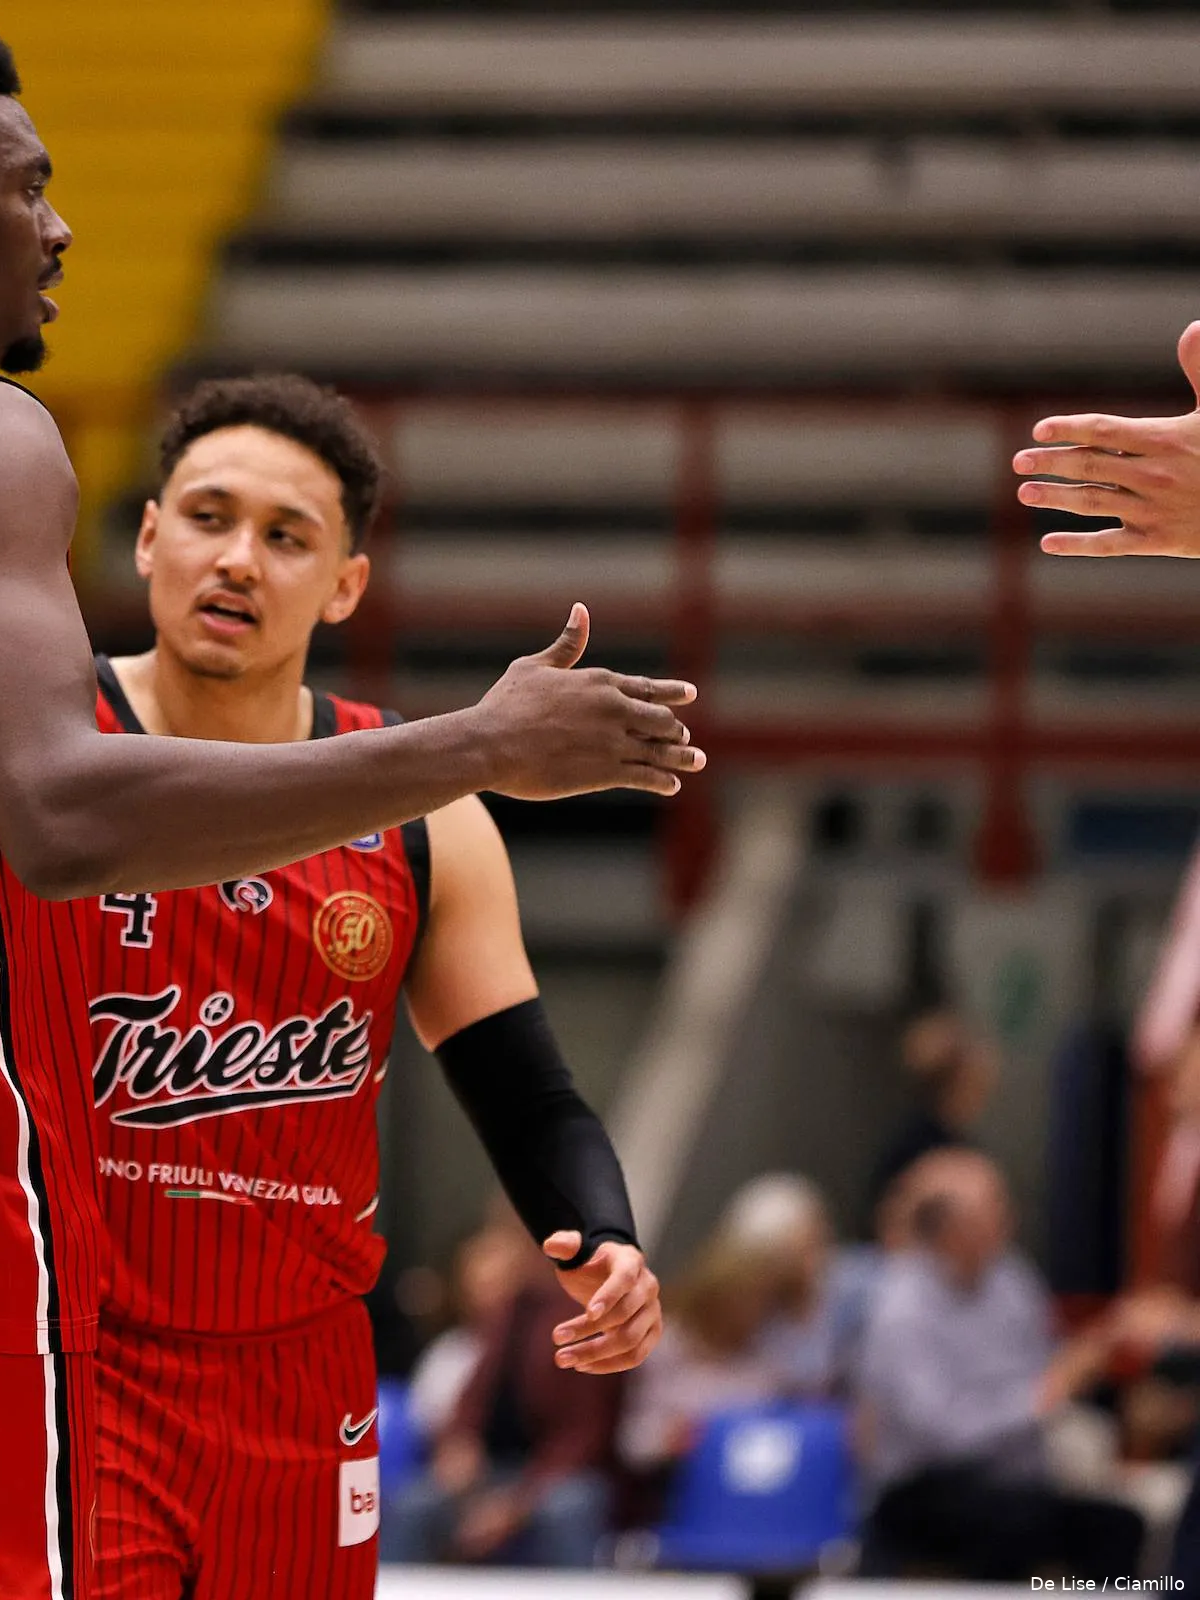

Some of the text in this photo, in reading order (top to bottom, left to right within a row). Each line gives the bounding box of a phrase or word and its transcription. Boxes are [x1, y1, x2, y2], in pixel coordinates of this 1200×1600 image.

[99, 892, 158, 949] 4
[90, 984, 374, 1129] Trieste
[148, 1162, 214, 1187] FRIULI
